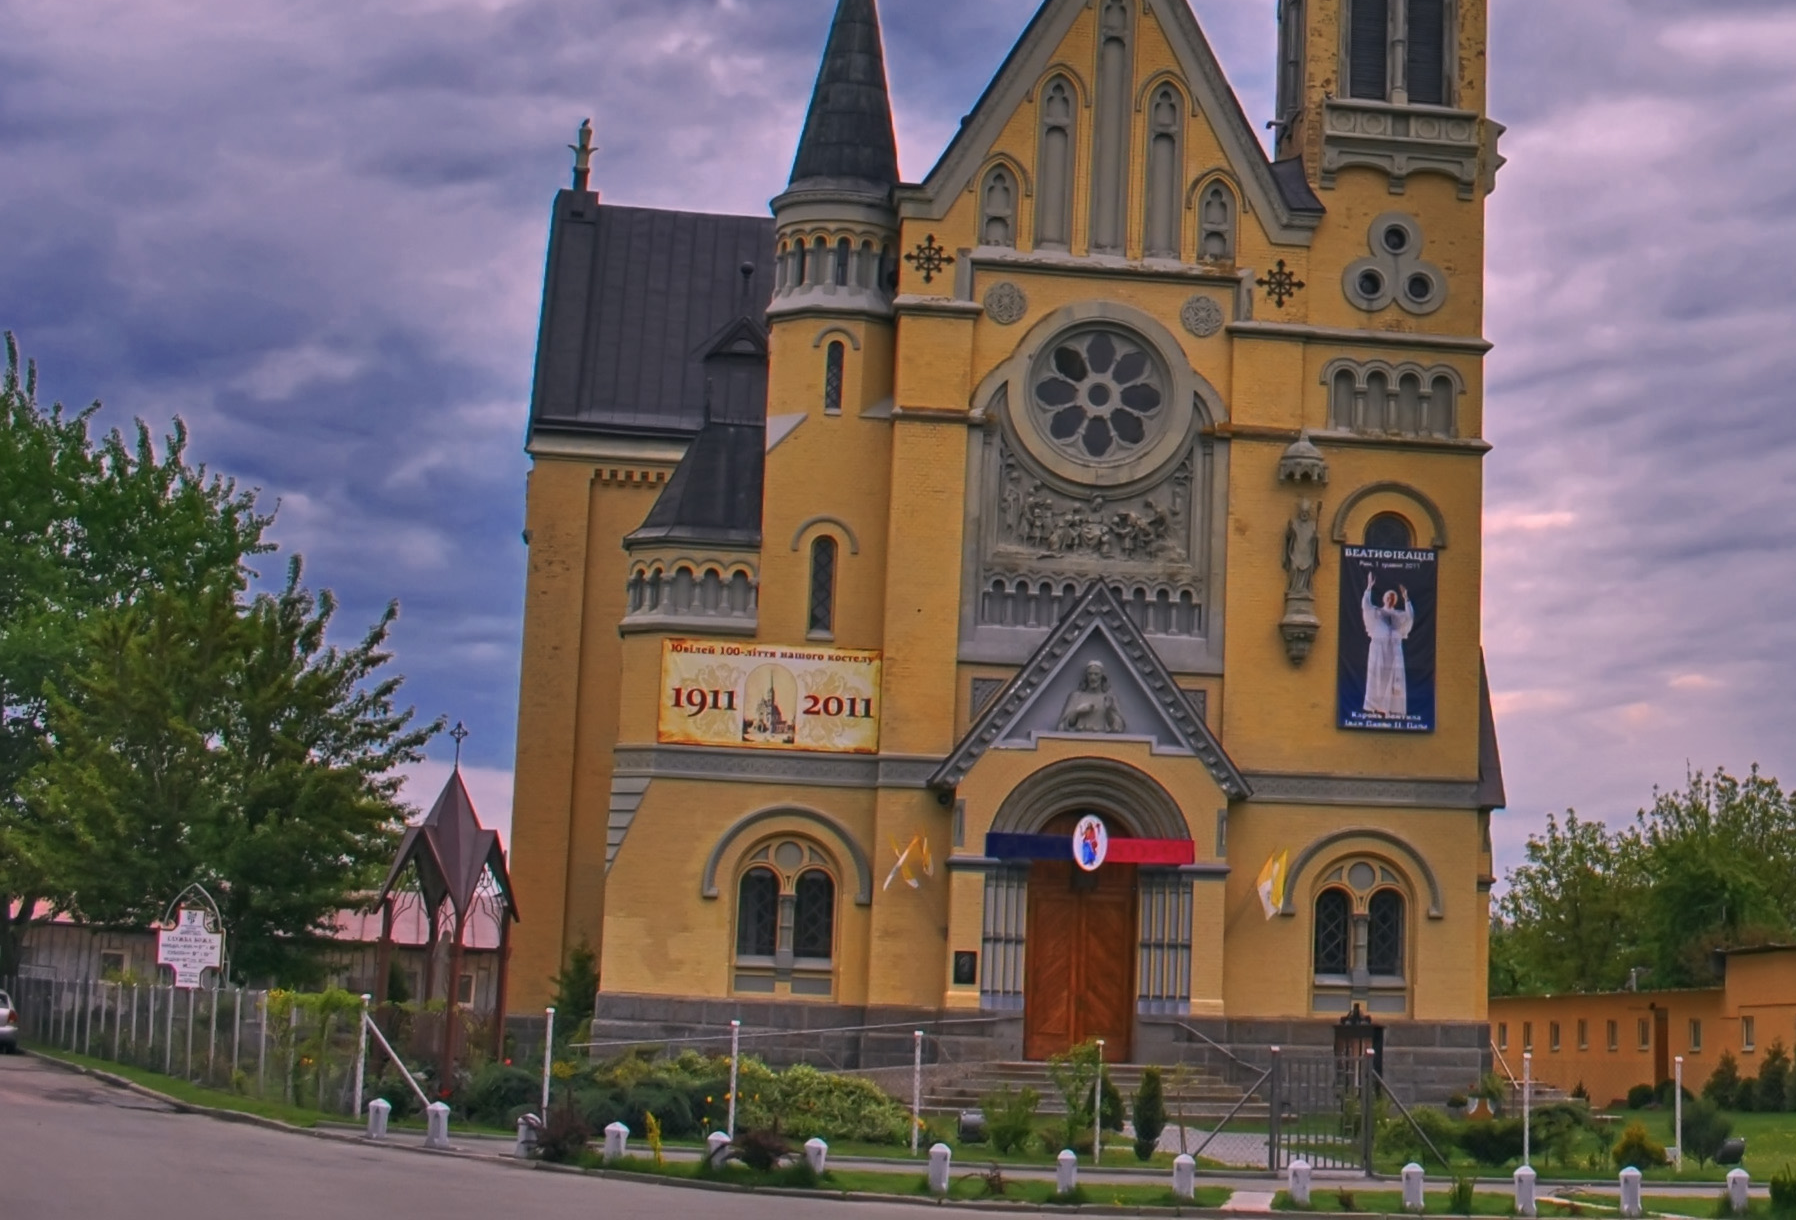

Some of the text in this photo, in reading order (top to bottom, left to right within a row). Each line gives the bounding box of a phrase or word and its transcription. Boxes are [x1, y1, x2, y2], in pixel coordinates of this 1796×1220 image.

[670, 643, 874, 665] Ювілей 100-ліття нашого костелу
[670, 686, 737, 717] 1911
[802, 694, 875, 719] 2011
